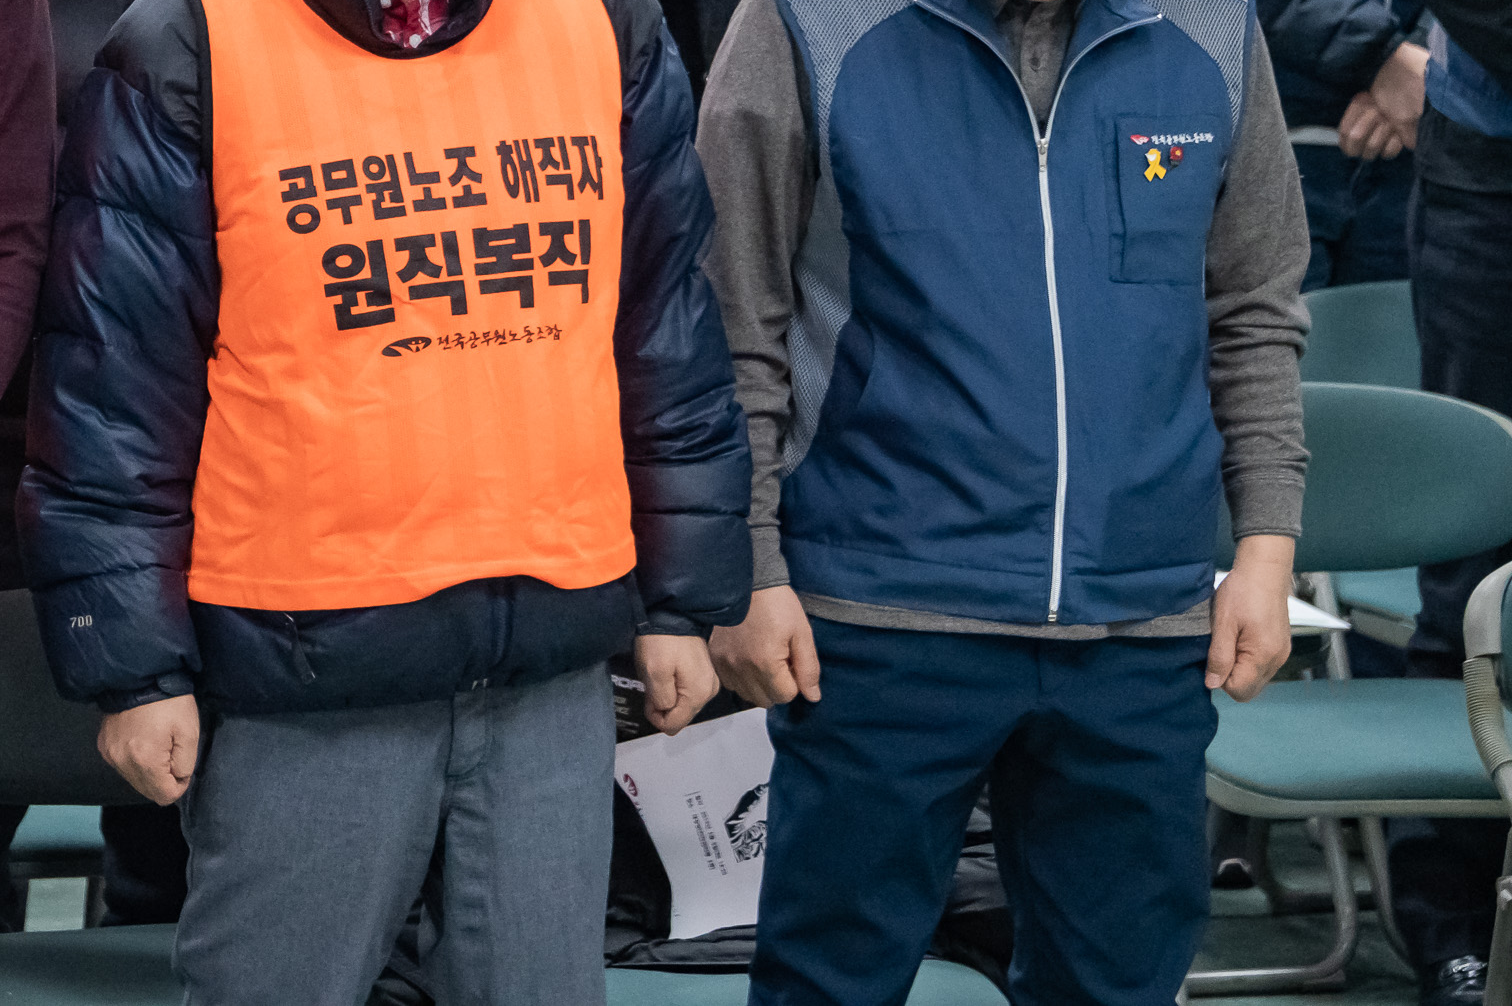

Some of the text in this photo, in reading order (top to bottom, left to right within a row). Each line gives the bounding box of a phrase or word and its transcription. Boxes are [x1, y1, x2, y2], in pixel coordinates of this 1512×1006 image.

[278, 135, 604, 235] 공무원노조 해직자
[321, 219, 591, 331] 원직복직
[437, 325, 562, 350] 전국공무원노동조합
[69, 614, 93, 628] 700
